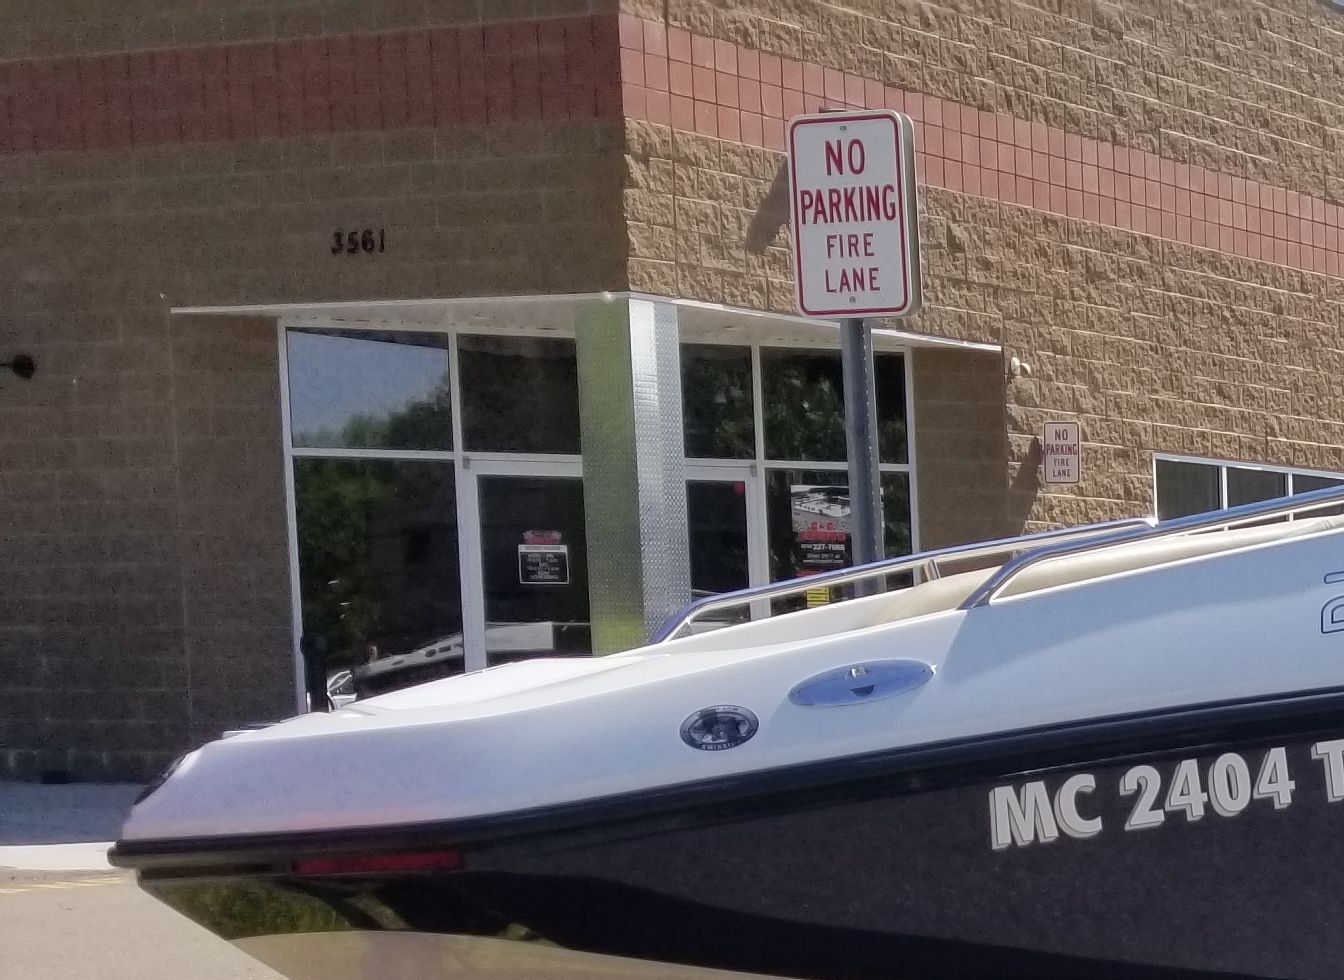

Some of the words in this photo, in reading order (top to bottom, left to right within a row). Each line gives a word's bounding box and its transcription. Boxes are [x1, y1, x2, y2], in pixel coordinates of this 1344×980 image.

[825, 138, 865, 176] NO
[800, 184, 897, 225] PARKING
[330, 228, 385, 255] 3561
[826, 233, 875, 259] FIRE
[825, 267, 881, 293] LANE
[1054, 428, 1069, 441] NO
[1046, 443, 1078, 456] PARKING
[1053, 457, 1071, 467] FIRE
[1052, 468, 1071, 478] LANE
[989, 773, 1103, 850] MC
[1119, 746, 1297, 831] 2404
